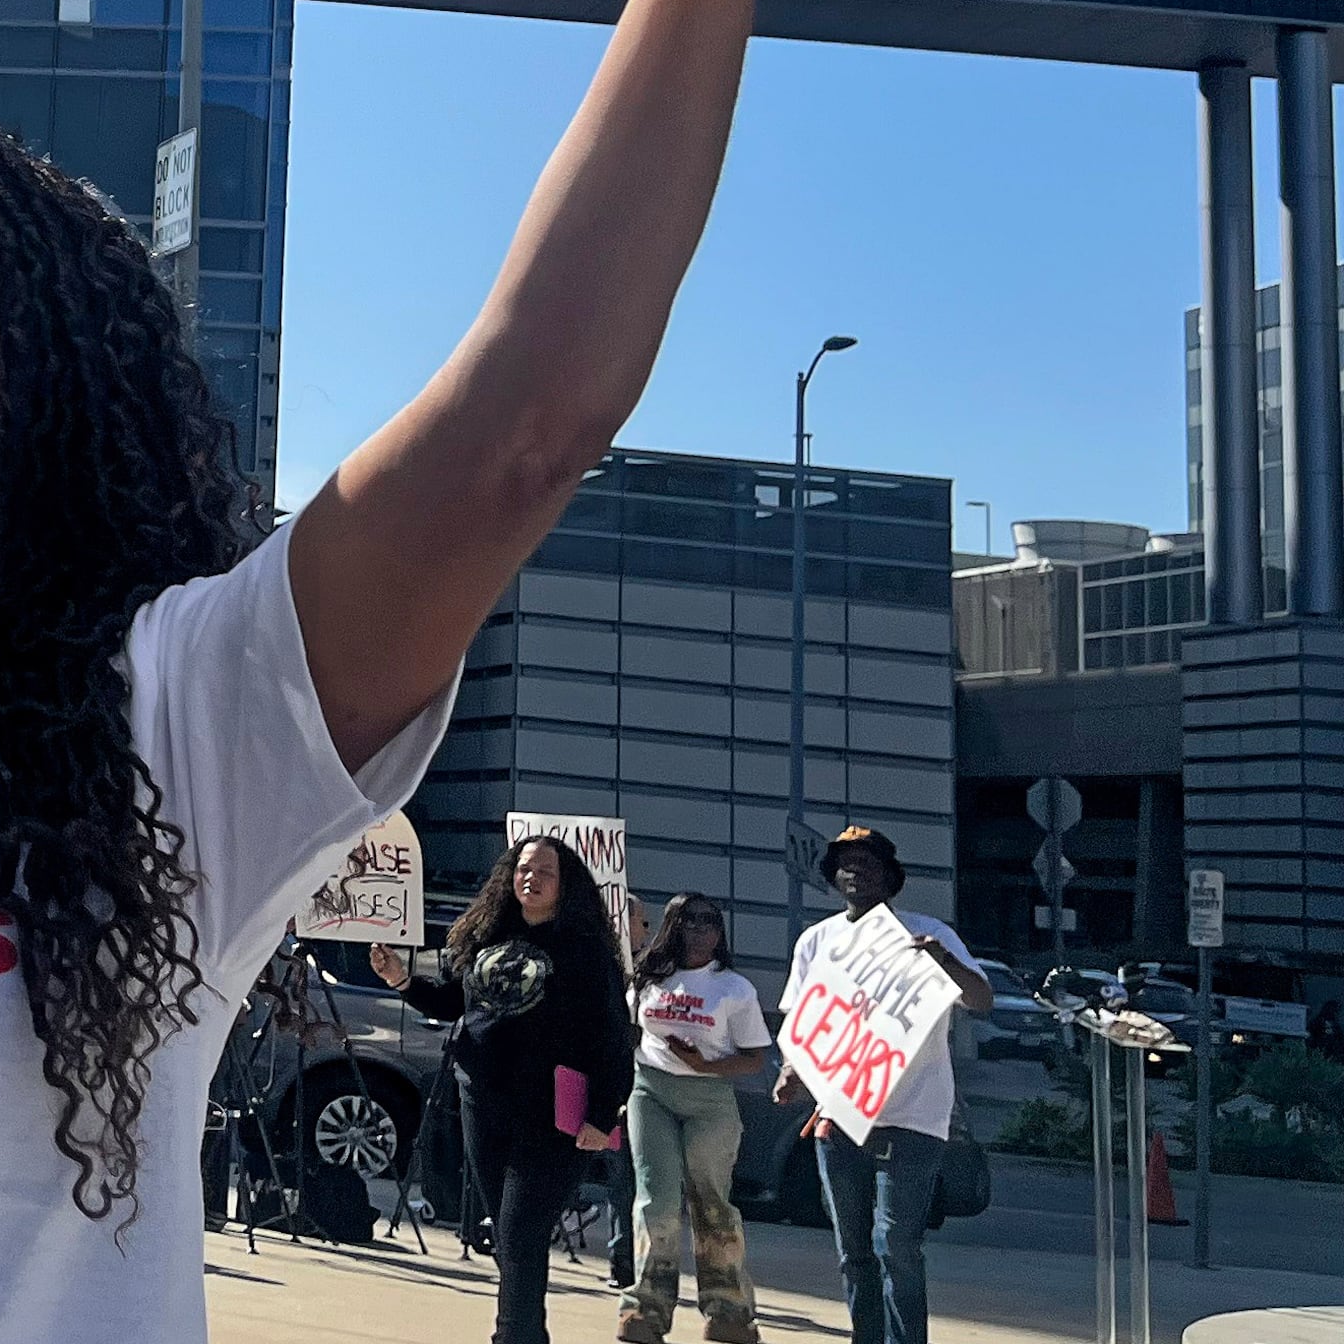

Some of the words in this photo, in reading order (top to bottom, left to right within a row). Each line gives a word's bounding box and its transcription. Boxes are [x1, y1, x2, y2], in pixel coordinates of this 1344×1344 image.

[156, 155, 169, 184] DO
[173, 144, 192, 177] NOT
[155, 185, 190, 221] BLOCK
[850, 989, 873, 1021] ON
[790, 982, 906, 1119] CEDARS
